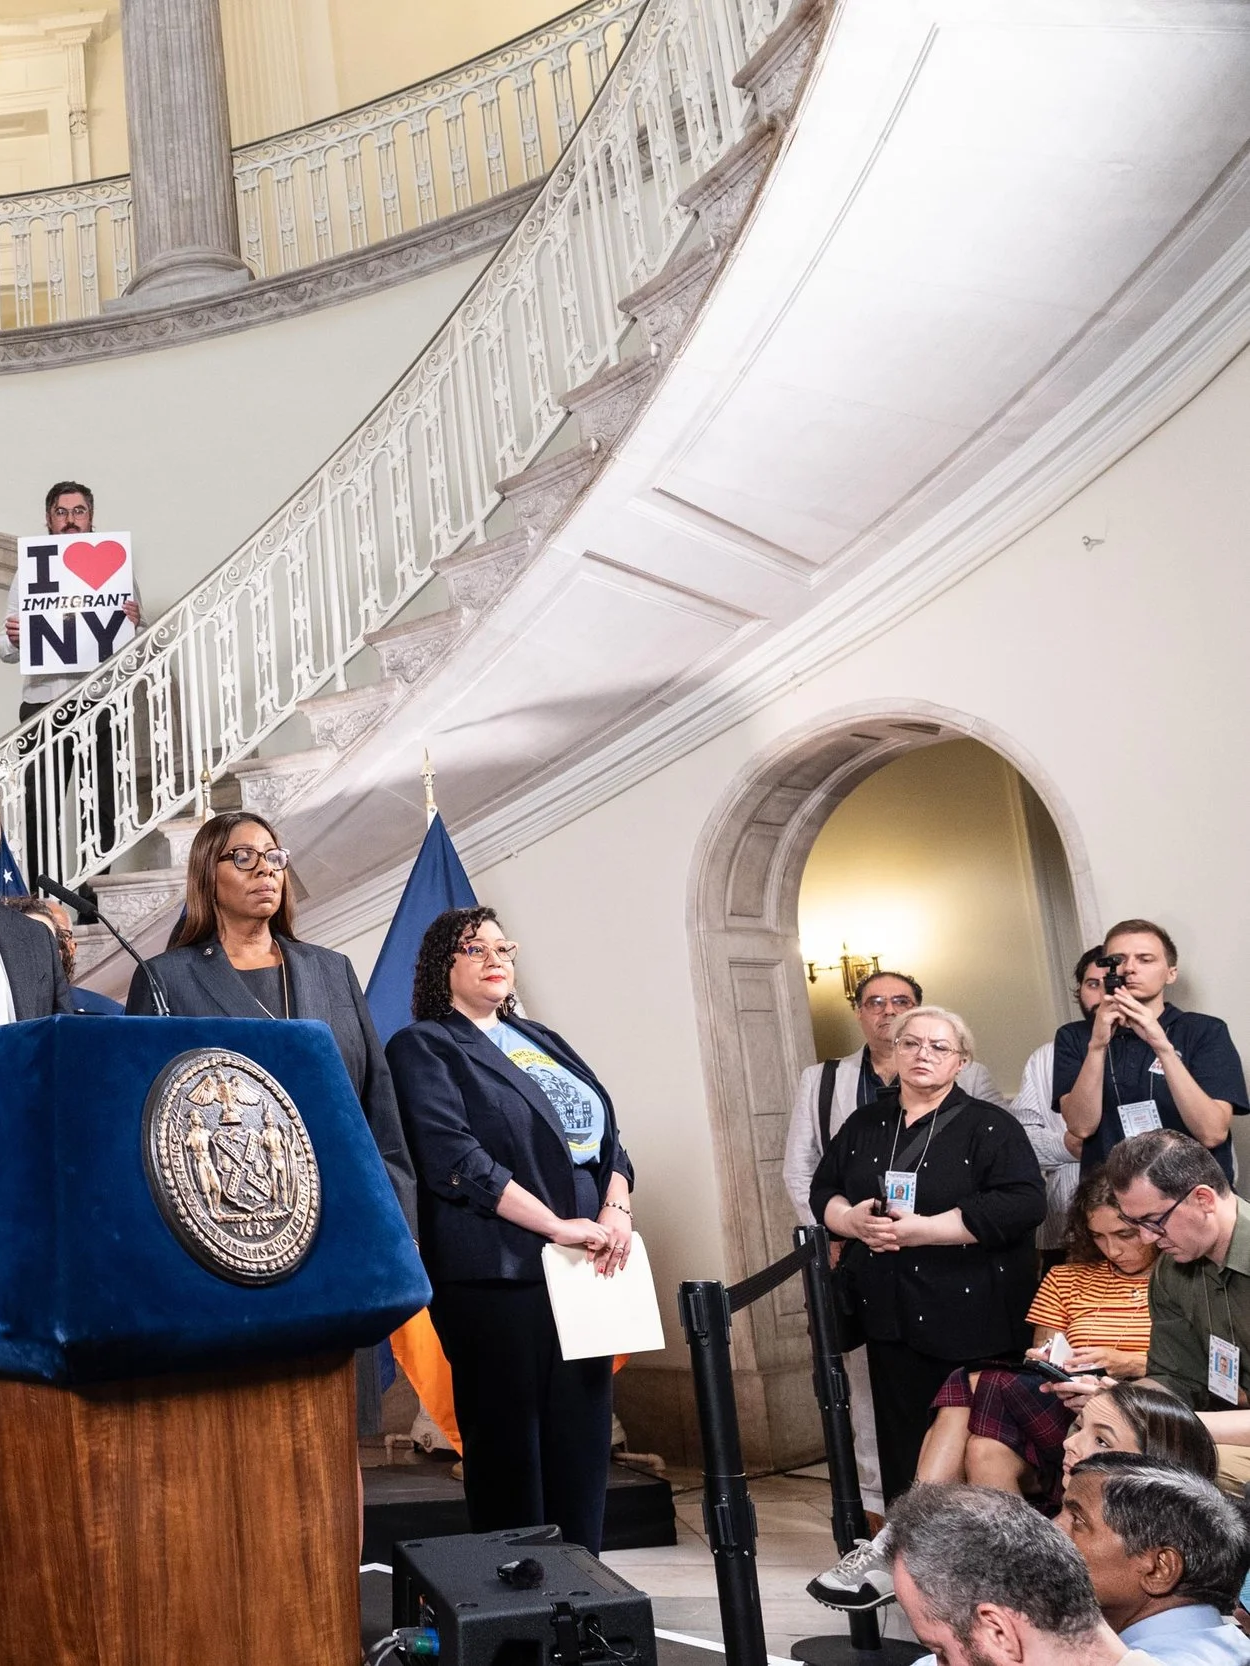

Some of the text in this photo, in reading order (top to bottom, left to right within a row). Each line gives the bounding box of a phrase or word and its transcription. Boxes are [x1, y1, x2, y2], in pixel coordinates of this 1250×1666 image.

[27, 545, 59, 594] I
[22, 593, 131, 611] IMMIGRANT
[29, 610, 127, 666] NY
